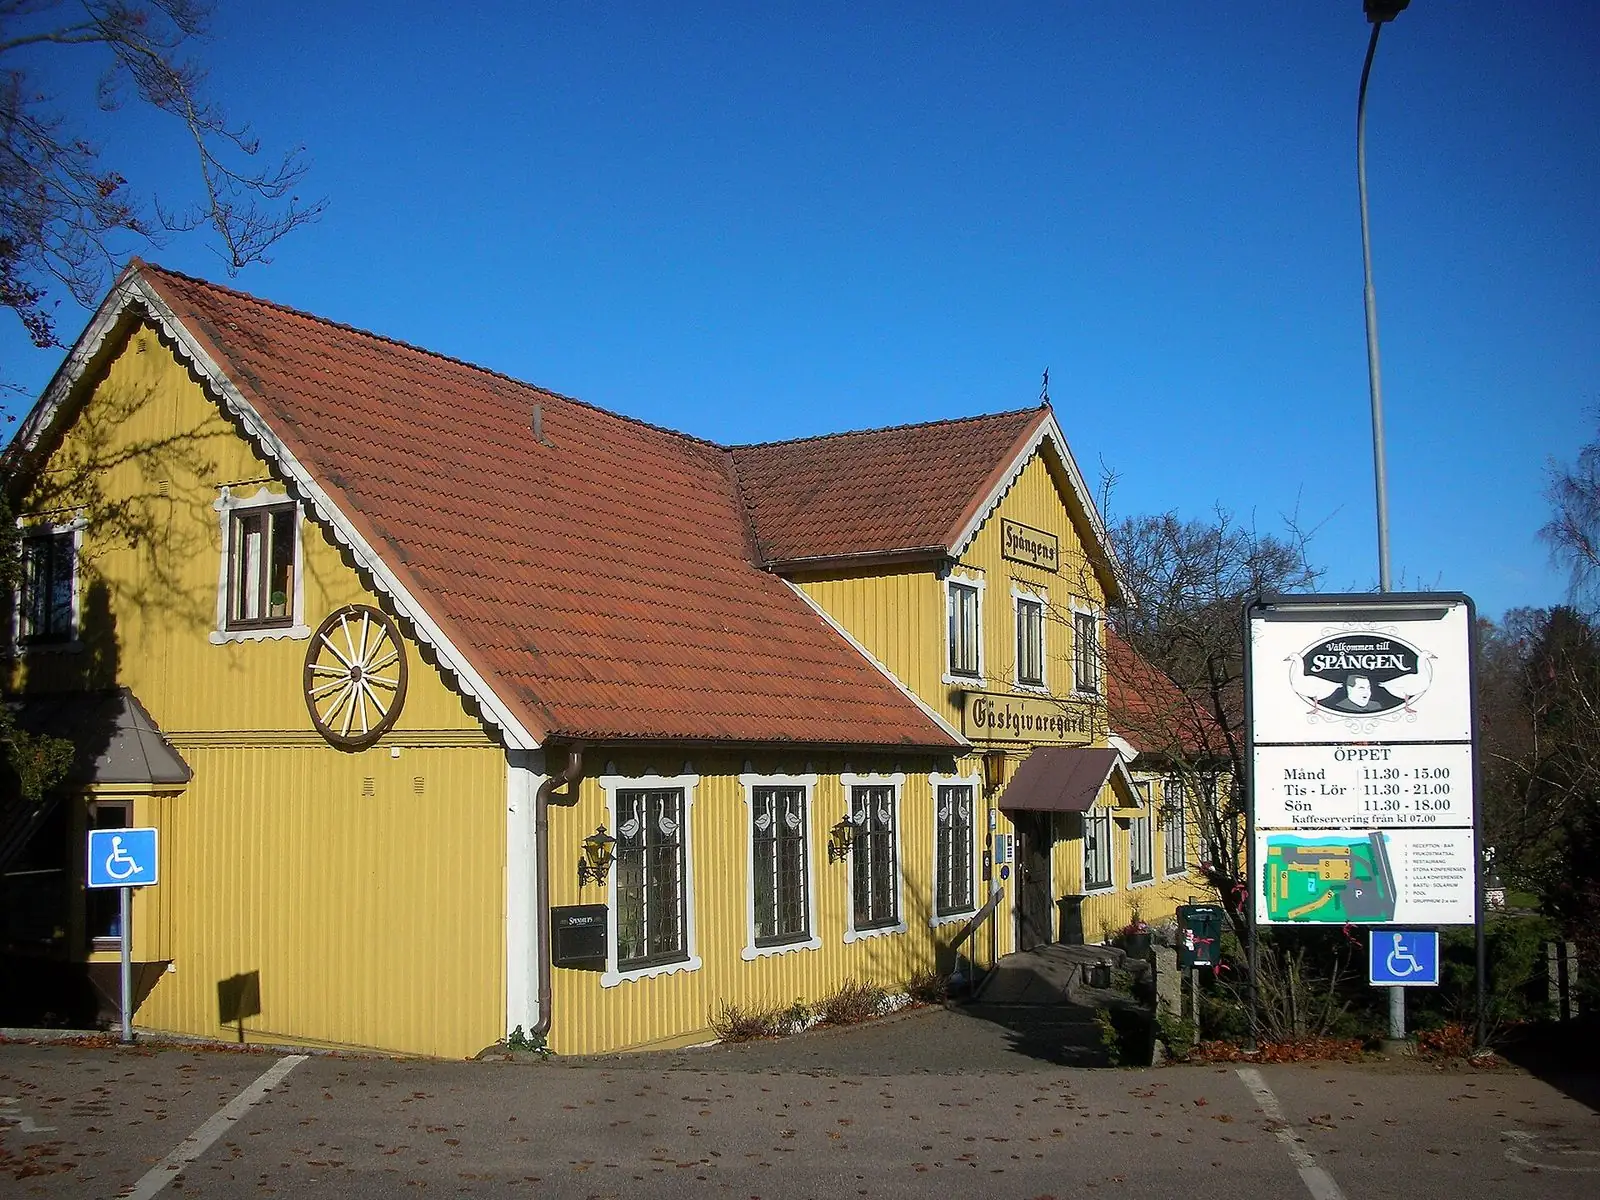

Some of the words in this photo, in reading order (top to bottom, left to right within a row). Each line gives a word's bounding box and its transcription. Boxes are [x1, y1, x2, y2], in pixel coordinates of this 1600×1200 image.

[1006, 525, 1055, 562] Spångens
[1326, 642, 1374, 652] Välkommen
[1376, 641, 1390, 651] till
[1310, 652, 1412, 672] SPÅNGEN
[1334, 747, 1392, 761] ÖPPET
[1284, 767, 1326, 780] Månd
[1364, 768, 1400, 779] 11.30
[1414, 768, 1450, 779] 15.00
[1284, 784, 1307, 796] Tis
[1320, 784, 1347, 796] Lör
[1364, 784, 1400, 795] 11.30
[1413, 784, 1450, 795] 21.00
[1284, 800, 1313, 811] Sön
[1364, 800, 1400, 811] 11.30
[1414, 799, 1451, 811] 18.00
[1292, 815, 1369, 824] Kaffeservering
[1372, 814, 1394, 823] från
[1397, 814, 1407, 823] kl
[1409, 814, 1436, 823] 07.00
[1355, 889, 1363, 898] P
